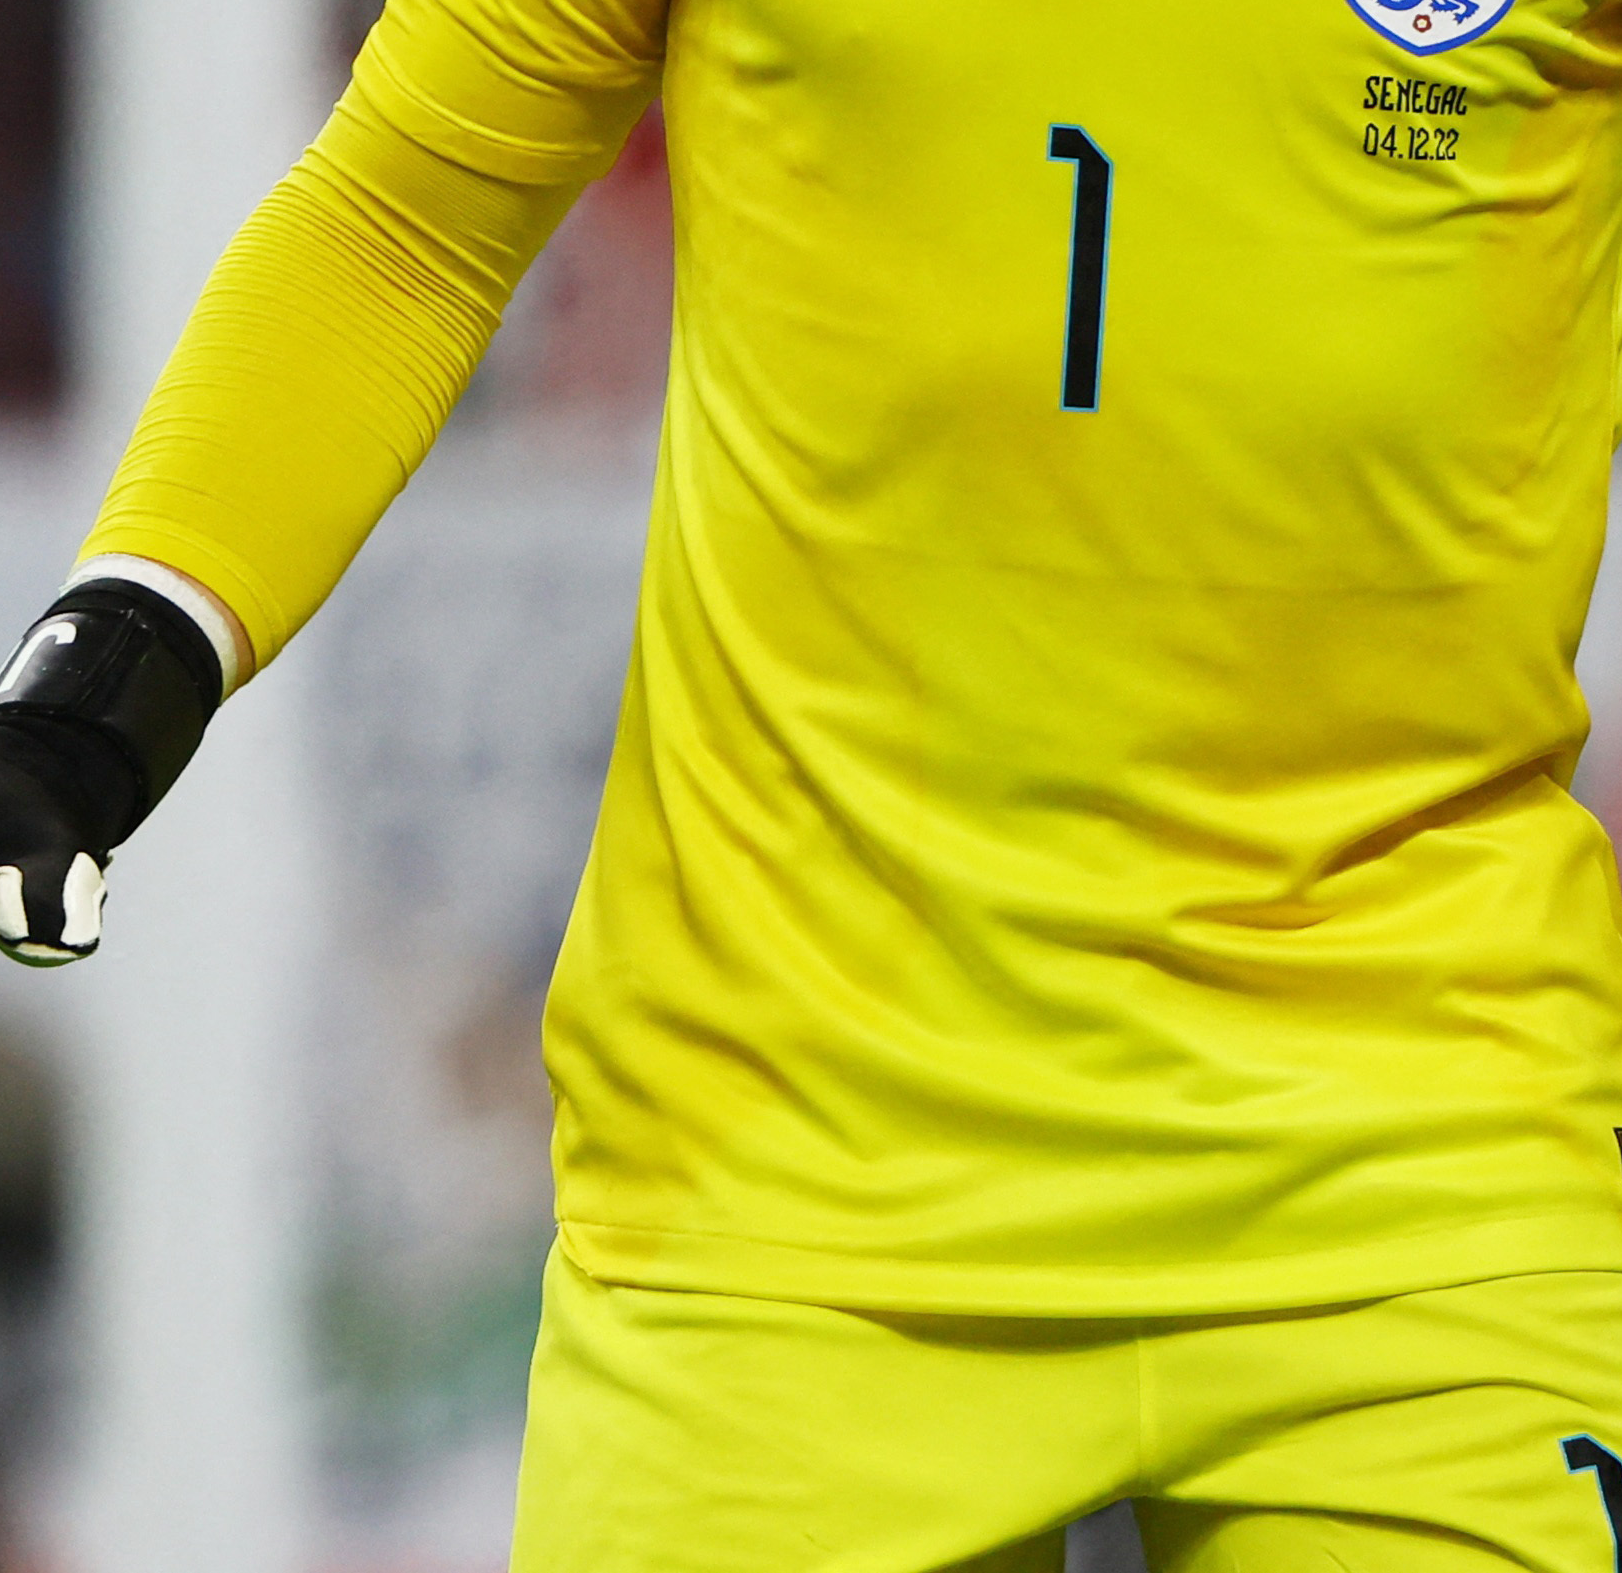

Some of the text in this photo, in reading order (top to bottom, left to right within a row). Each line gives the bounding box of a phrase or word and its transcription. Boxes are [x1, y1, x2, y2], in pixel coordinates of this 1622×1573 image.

[1363, 76, 1467, 115] SENEGAL
[1363, 122, 1460, 160] 04.12.22
[1046, 122, 1114, 413] 1
